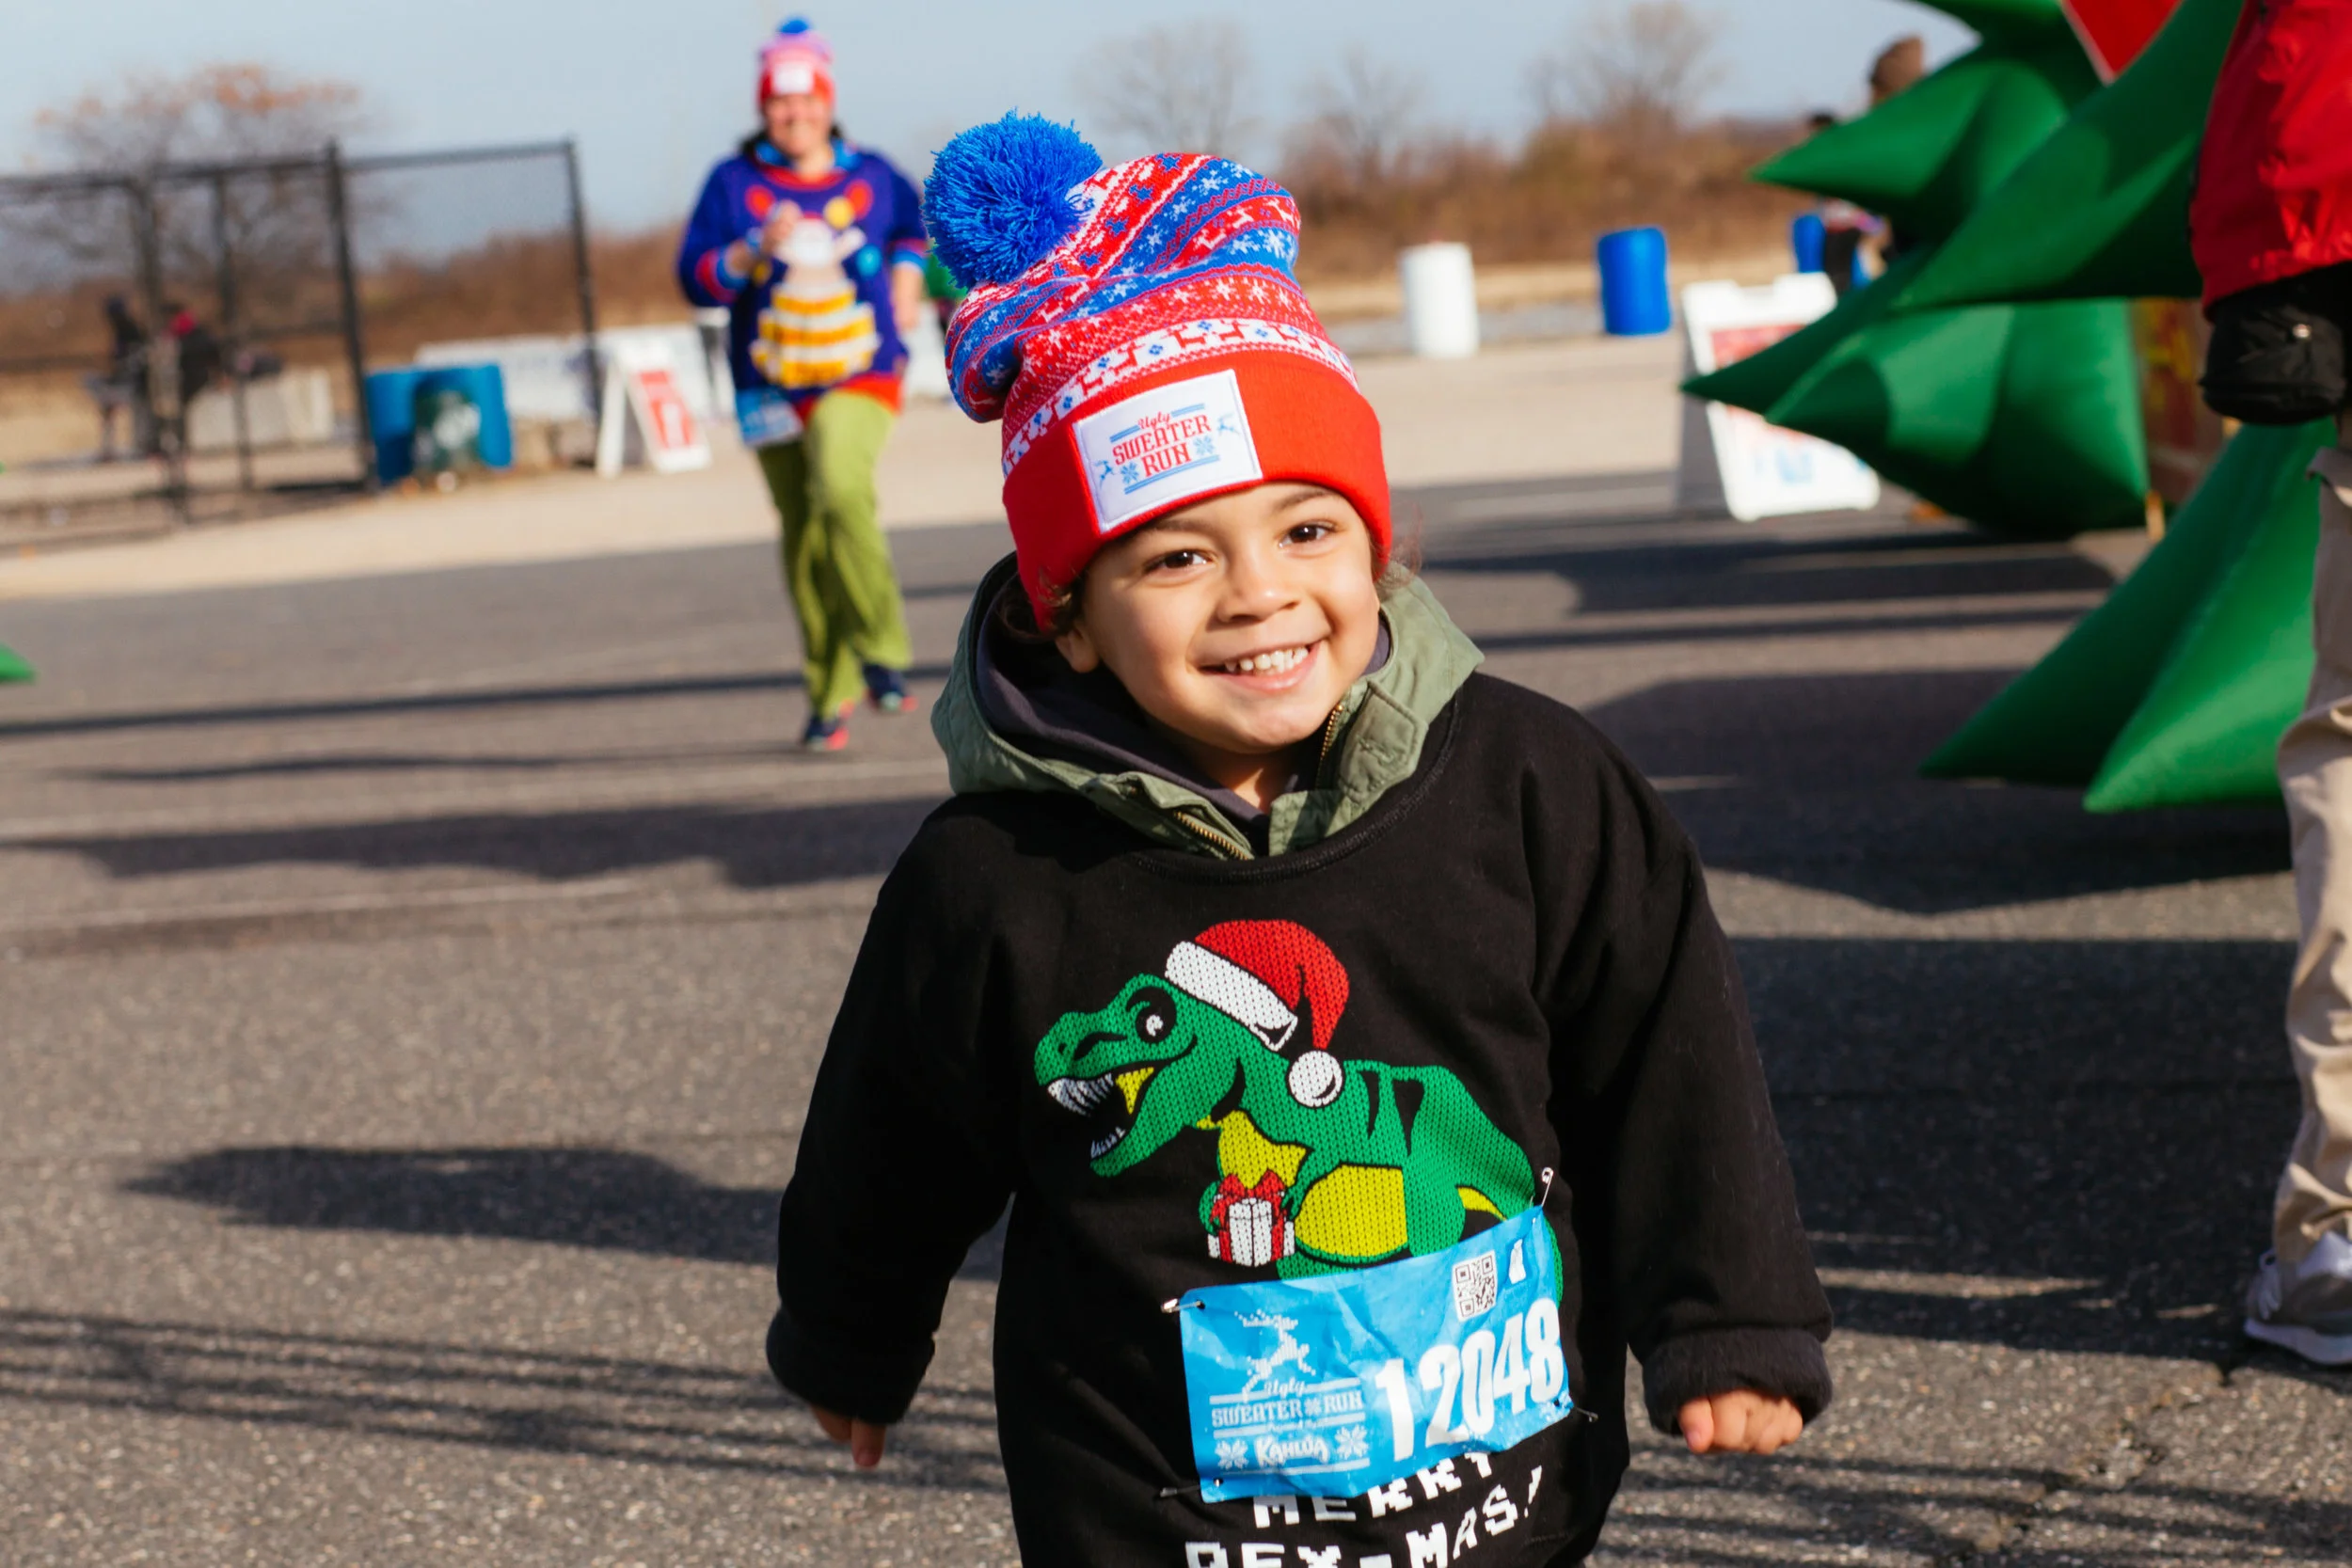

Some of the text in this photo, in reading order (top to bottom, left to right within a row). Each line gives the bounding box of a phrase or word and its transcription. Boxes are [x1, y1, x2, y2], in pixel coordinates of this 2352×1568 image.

[1112, 414, 1212, 466] SWEATER
[1141, 442, 1192, 477] RUN
[1375, 1297, 1565, 1463] 12048
[1211, 1399, 1303, 1428] SWEATER
[1323, 1389, 1363, 1414] RUN
